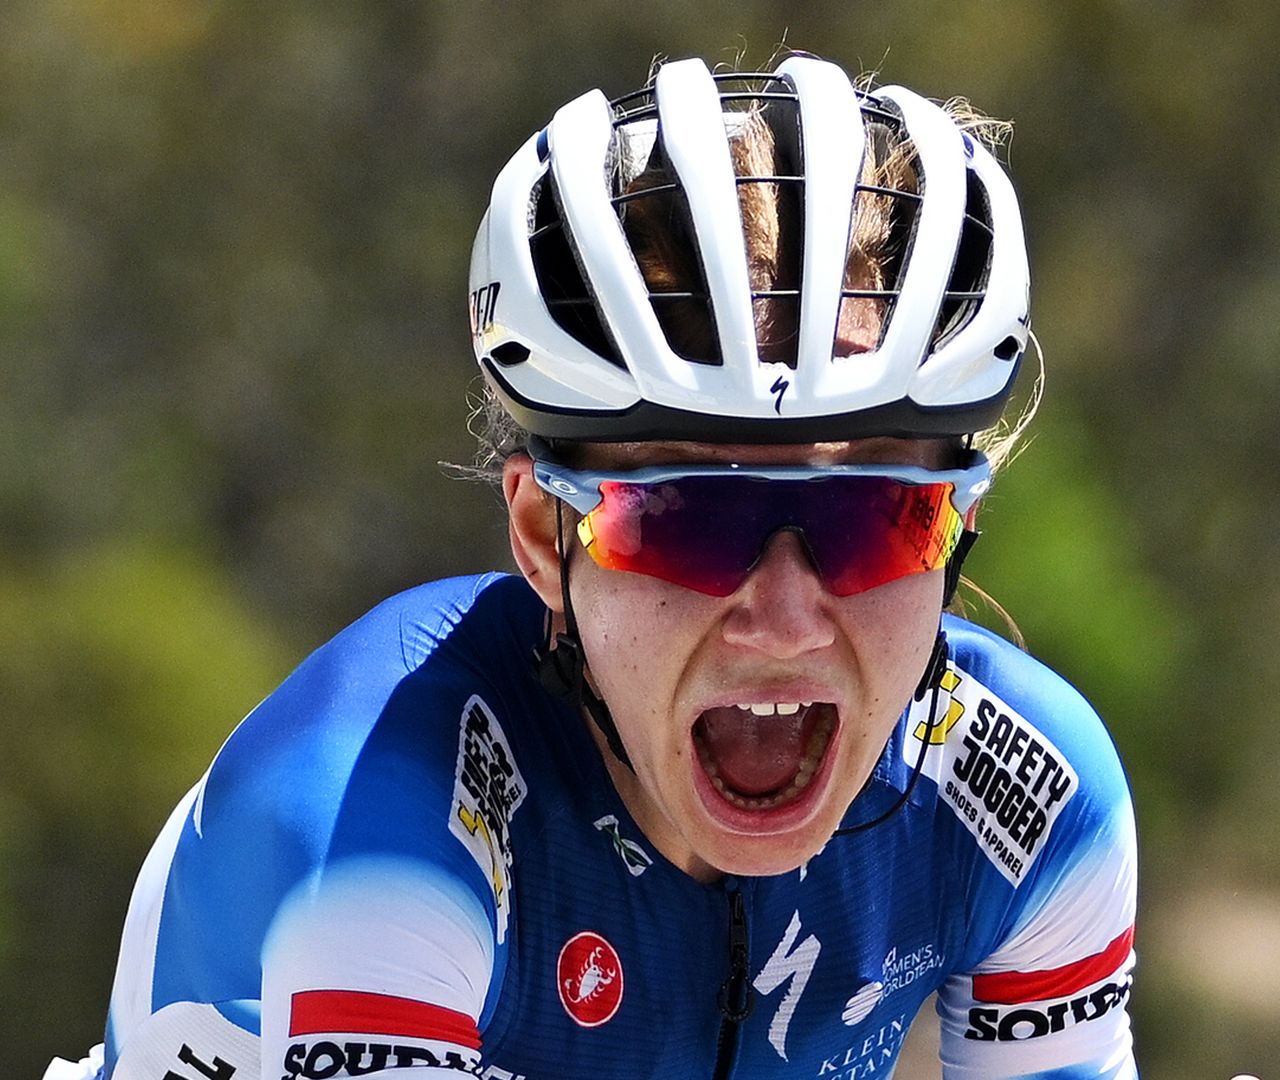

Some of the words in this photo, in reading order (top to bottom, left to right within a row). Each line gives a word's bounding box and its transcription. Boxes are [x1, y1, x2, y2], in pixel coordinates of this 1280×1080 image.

[953, 735, 1047, 856] JOGGER
[970, 698, 1071, 811] SAFETY
[945, 781, 978, 822] SHOES
[982, 826, 1024, 879] APPAREL
[817, 1013, 906, 1076] KLEIN
